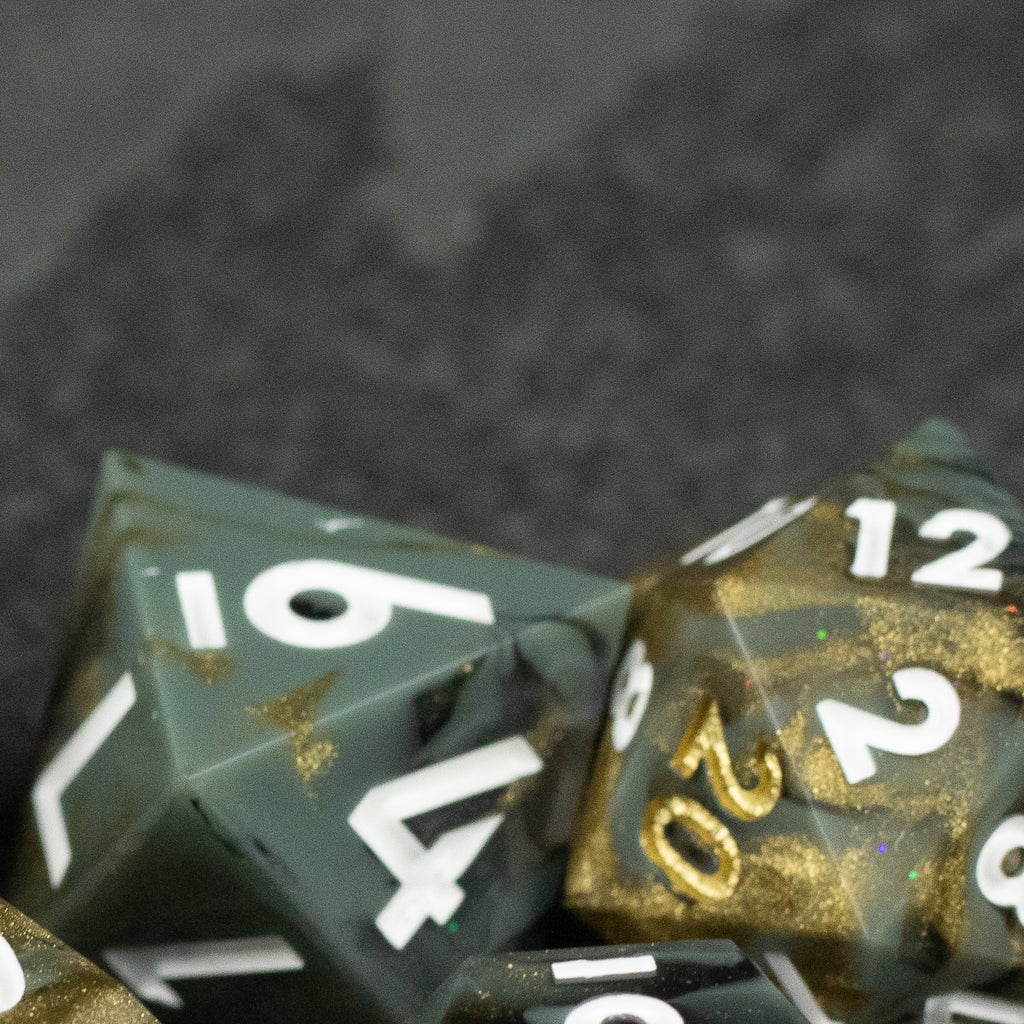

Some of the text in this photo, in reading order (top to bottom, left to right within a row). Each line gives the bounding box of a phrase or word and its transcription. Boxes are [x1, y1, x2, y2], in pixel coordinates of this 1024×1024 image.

[845, 498, 1011, 592] 12
[640, 692, 783, 900] 20
[815, 667, 961, 785] 2
[347, 735, 543, 950] 4
